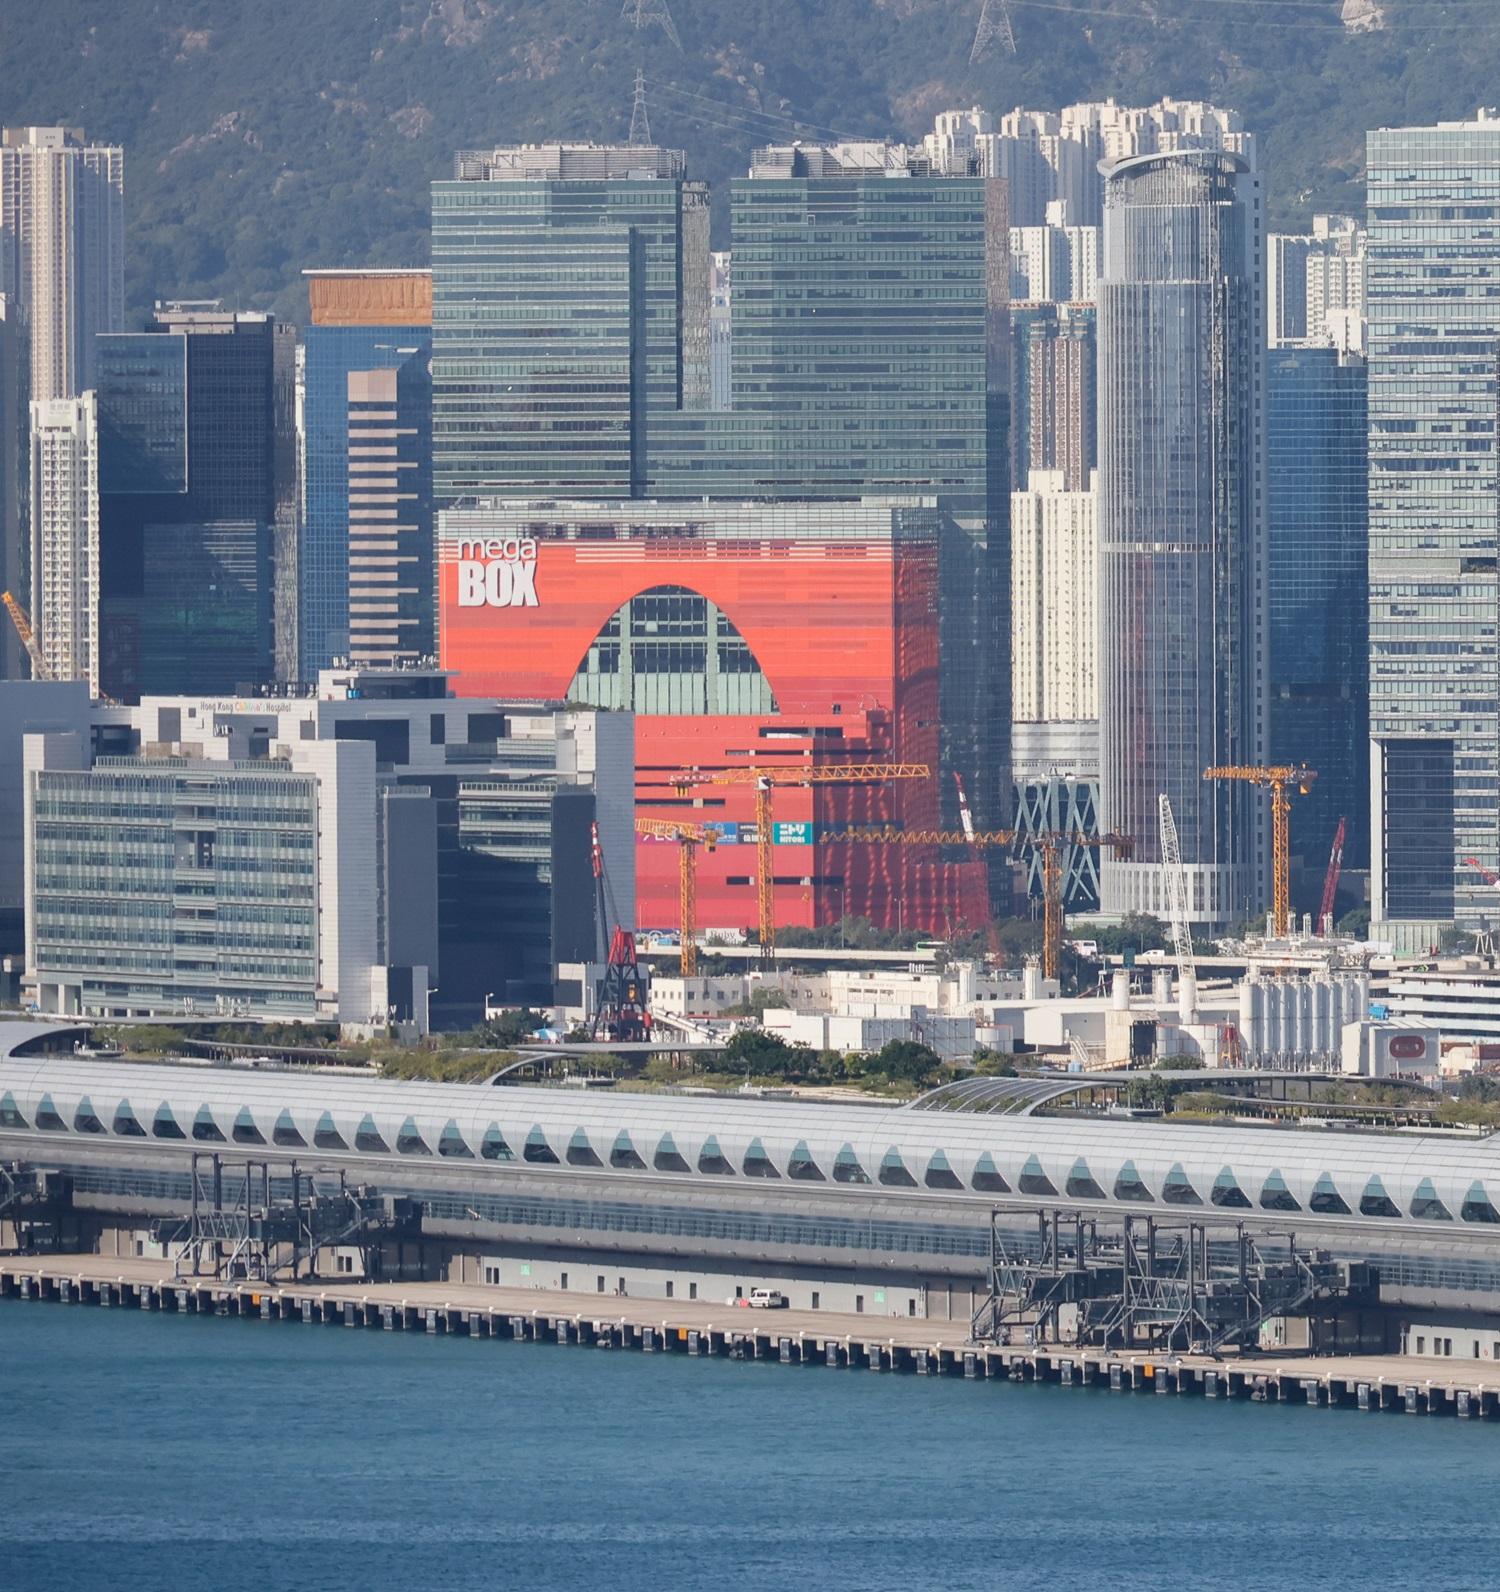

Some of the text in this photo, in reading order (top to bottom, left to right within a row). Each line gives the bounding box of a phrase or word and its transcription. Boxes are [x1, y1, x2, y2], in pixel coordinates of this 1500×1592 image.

[458, 536, 537, 564] mega
[458, 560, 539, 607] BOX
[200, 701, 216, 713] Hong
[217, 702, 234, 714] Kong
[266, 702, 292, 715] Hospital
